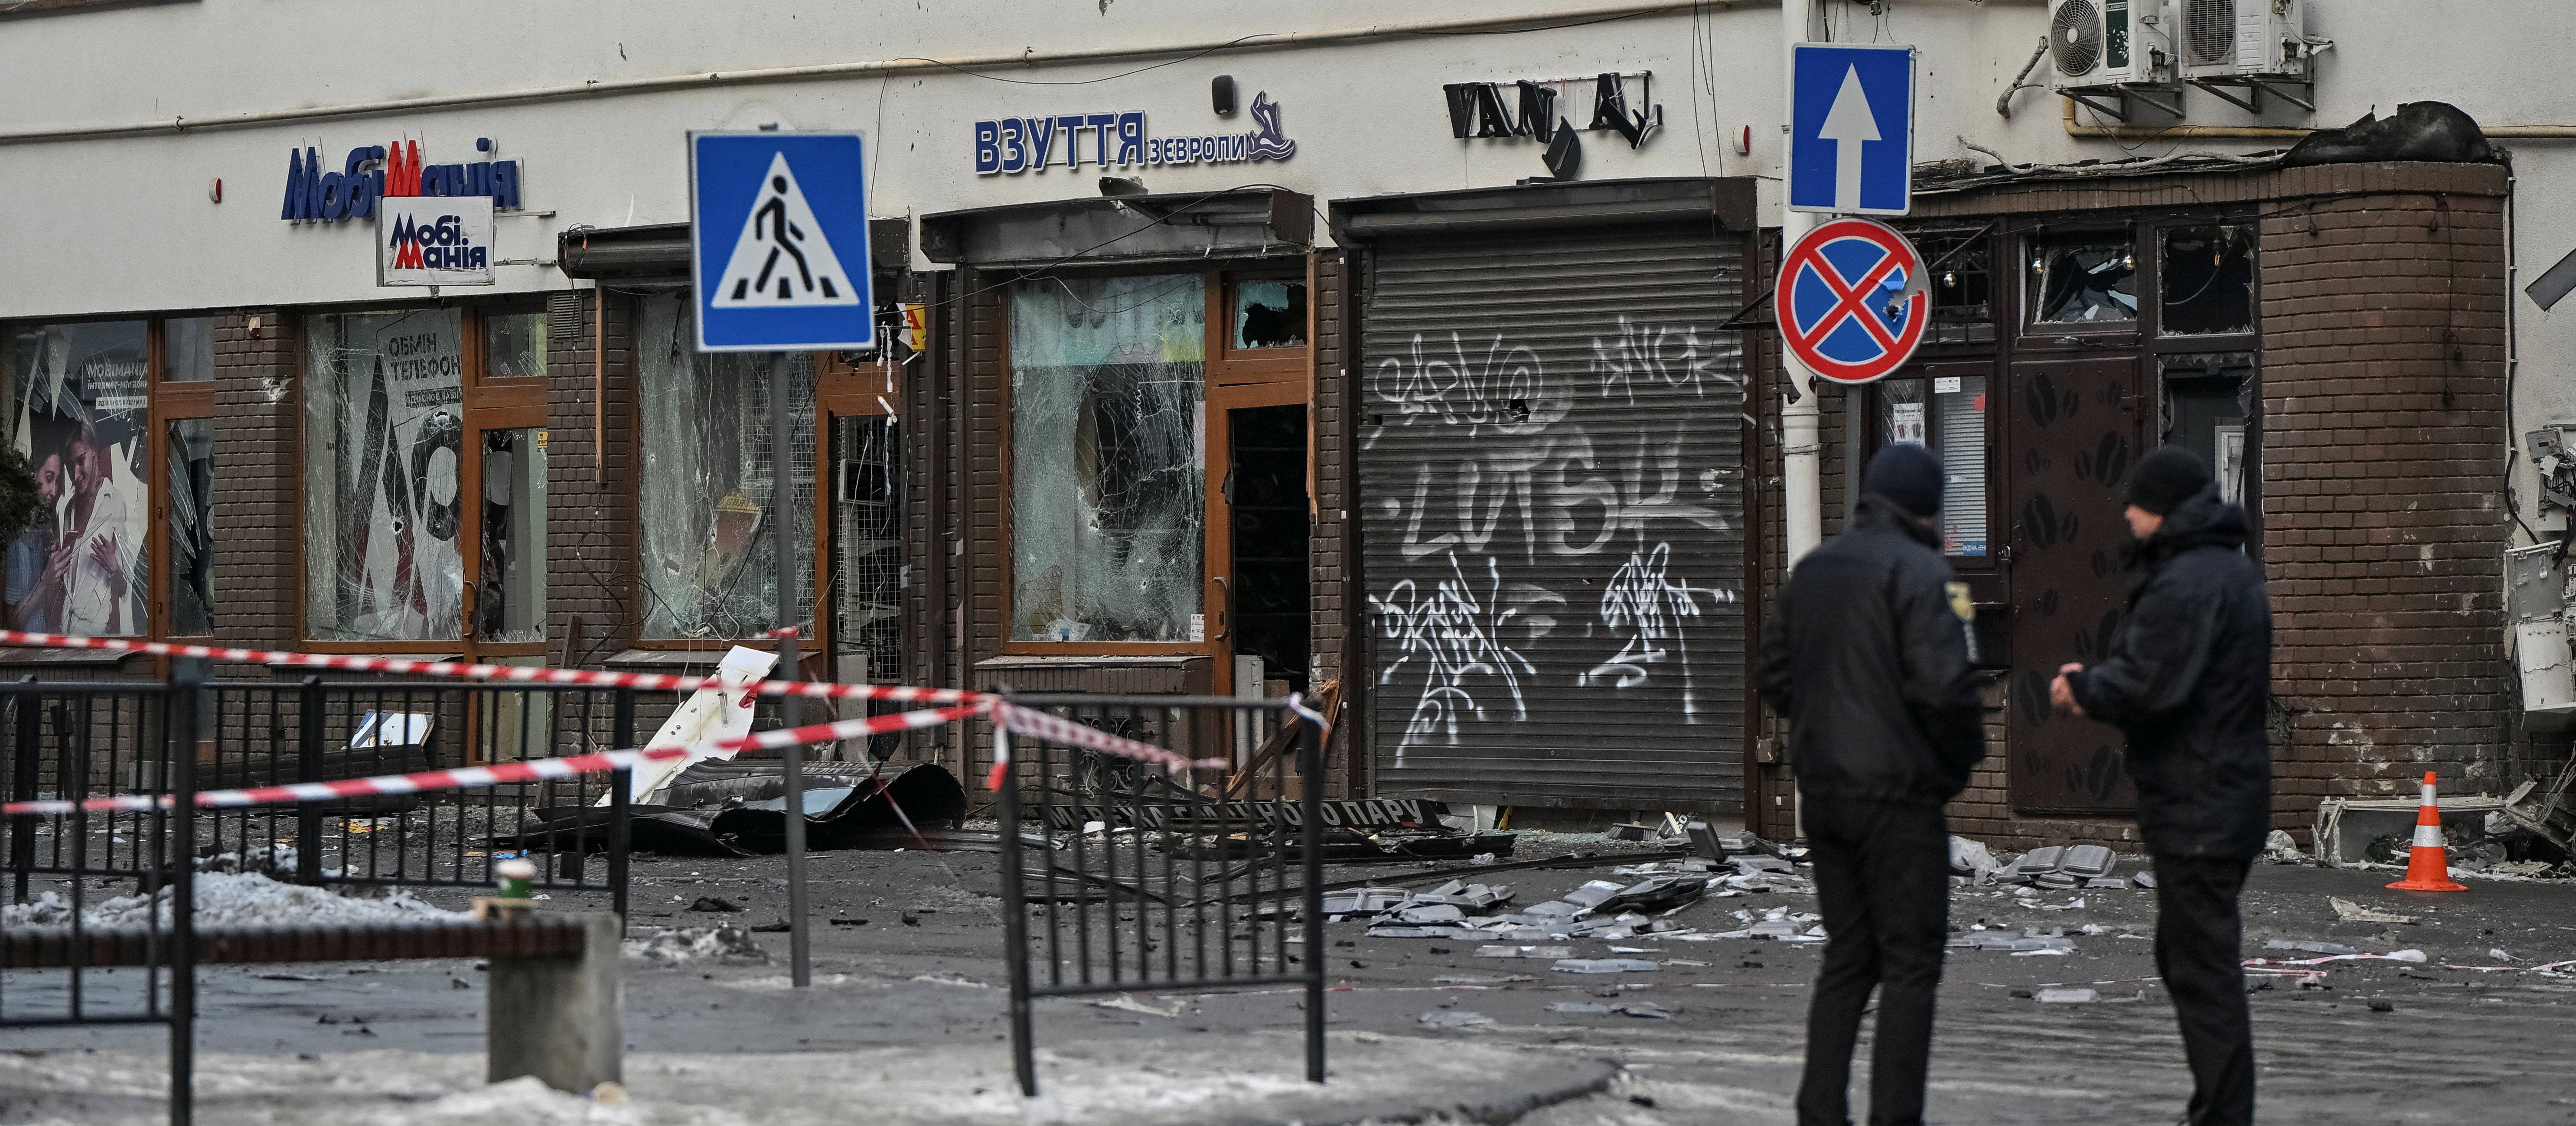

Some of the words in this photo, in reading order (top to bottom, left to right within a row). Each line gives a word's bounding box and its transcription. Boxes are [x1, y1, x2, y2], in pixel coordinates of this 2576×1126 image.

[975, 110, 1145, 173] ВЗУТТЯ
[389, 332, 437, 357] ОБМІН
[1341, 800, 1424, 825] ПАРУ
